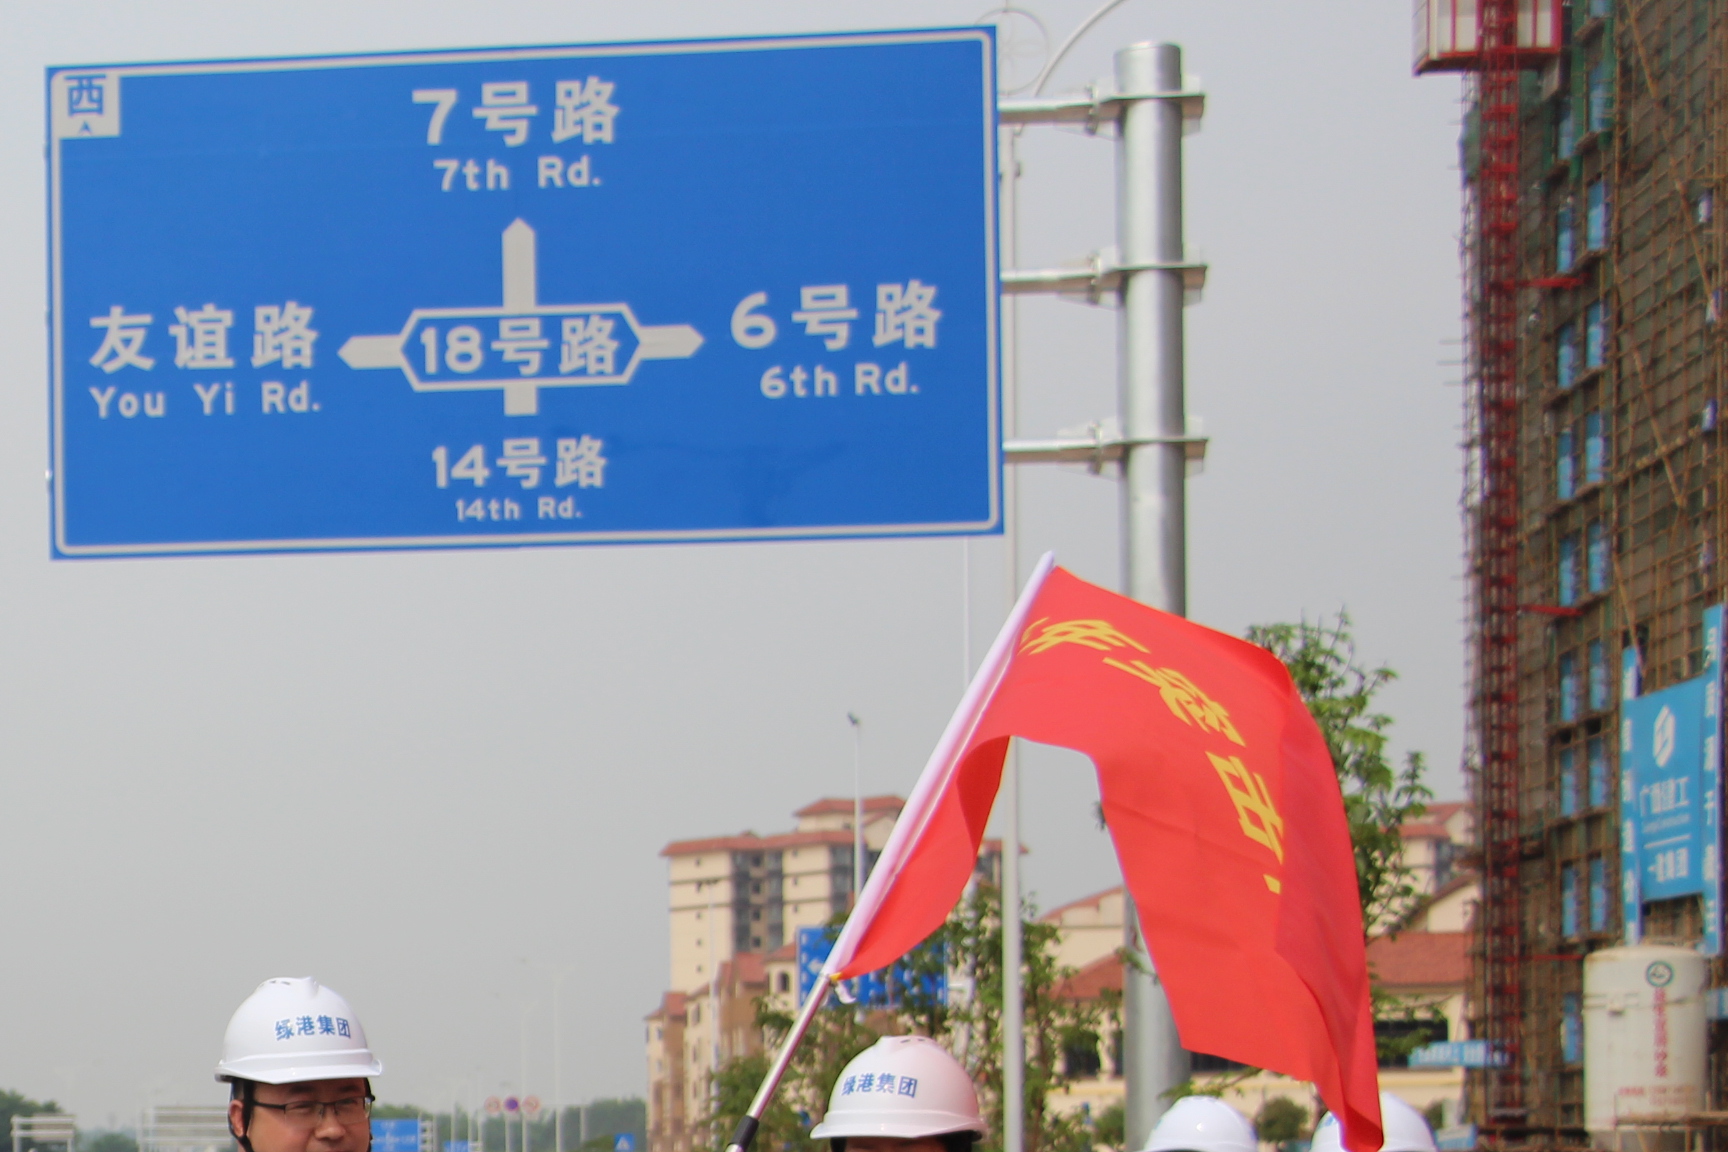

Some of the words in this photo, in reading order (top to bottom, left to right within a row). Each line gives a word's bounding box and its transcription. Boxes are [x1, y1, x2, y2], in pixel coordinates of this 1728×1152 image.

[64, 74, 106, 117] 西
[412, 75, 620, 146] 7号路
[433, 158, 509, 191] 7th
[538, 154, 601, 188] Rd.
[731, 279, 942, 350] 6号路
[89, 301, 319, 373] 友谊路
[420, 315, 619, 376] 18号路
[89, 386, 165, 418] You
[193, 381, 234, 415] Yi
[261, 380, 320, 413] Rd.
[760, 365, 838, 398] 6th
[855, 362, 919, 394] Rd.
[432, 435, 607, 488] 14号路
[456, 498, 520, 521] 14th
[538, 496, 581, 518] Rd.
[275, 1014, 351, 1041] 绿港集团
[841, 1072, 918, 1099] 绿港集团
